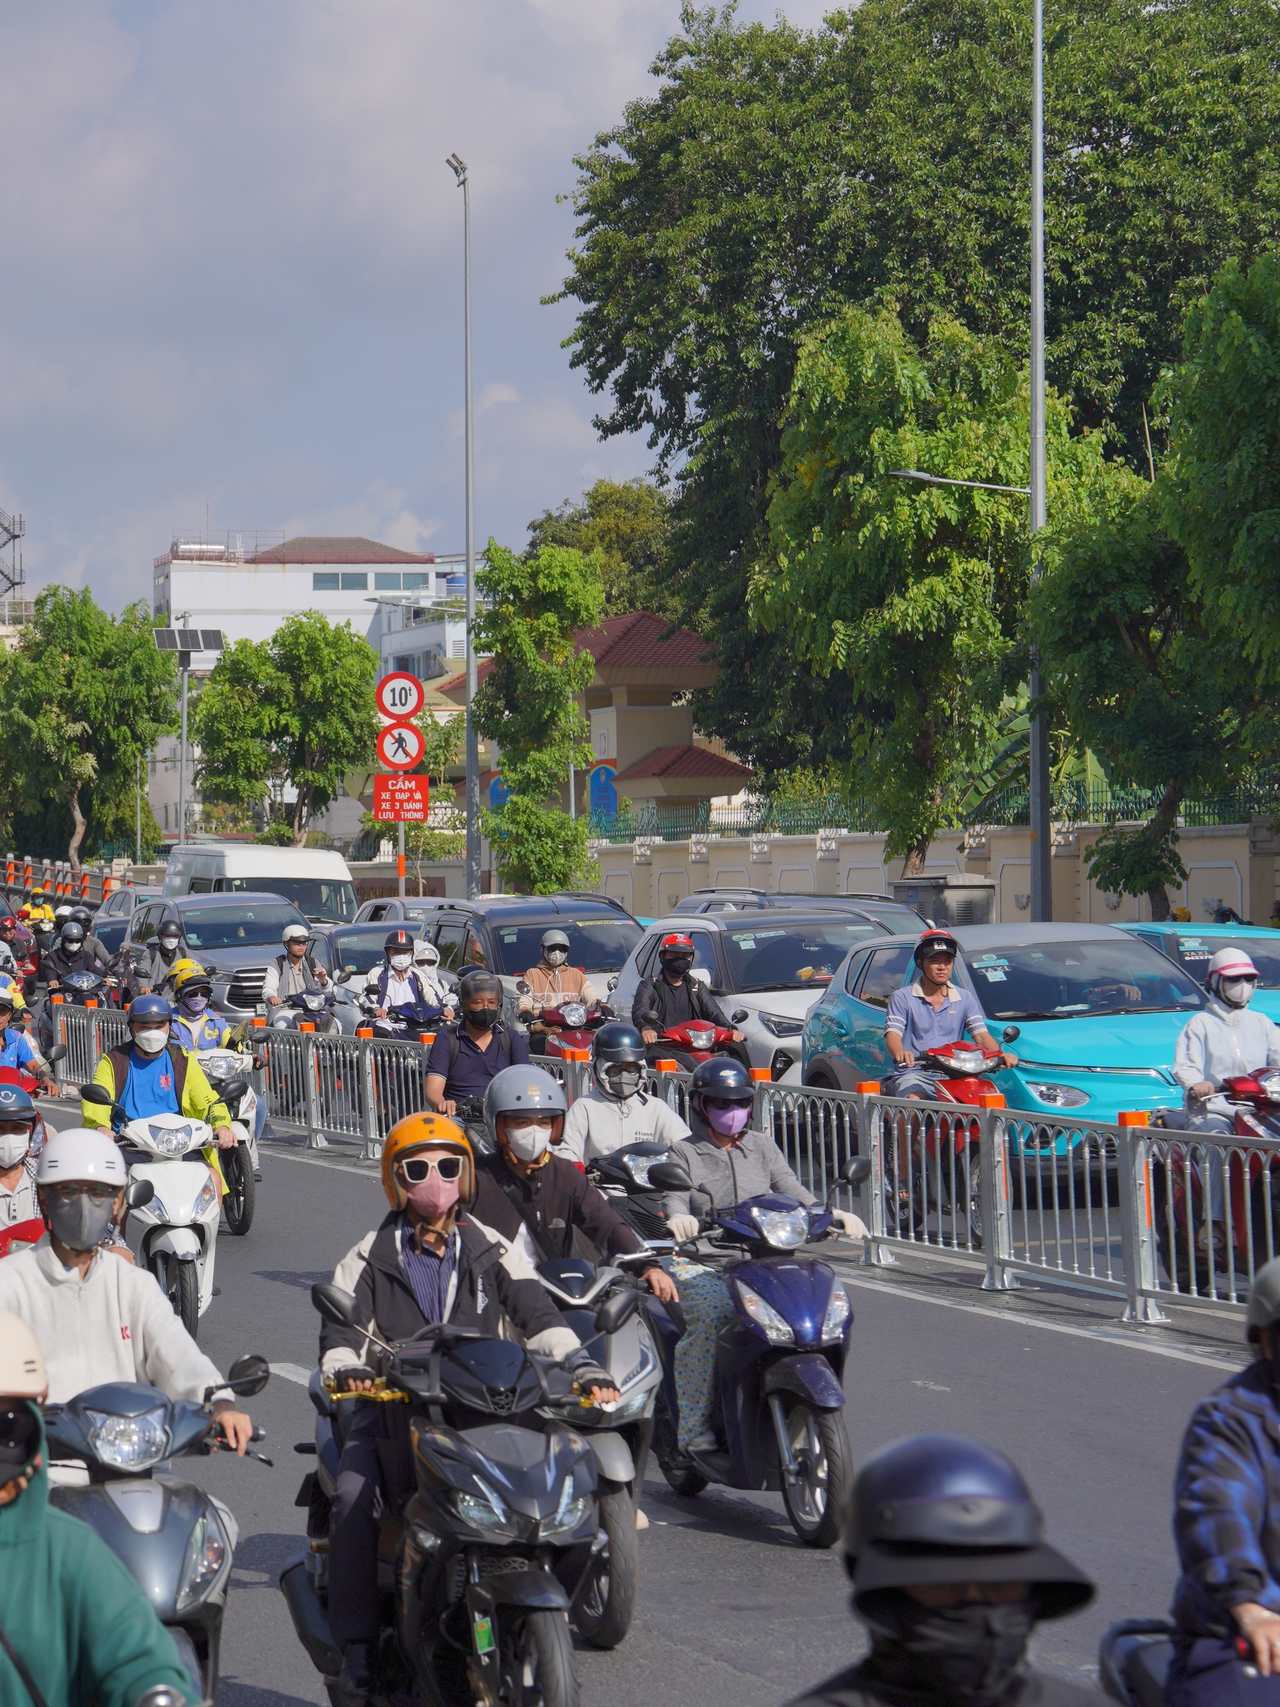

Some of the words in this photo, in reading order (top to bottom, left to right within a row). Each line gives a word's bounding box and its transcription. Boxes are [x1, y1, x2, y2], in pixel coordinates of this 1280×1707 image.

[388, 776, 416, 790] CẤM
[381, 792, 391, 800] XE
[395, 792, 410, 801] ĐẠP
[413, 791, 423, 800] VÀ
[381, 802, 391, 810] XE
[394, 802, 400, 810] 3
[403, 801, 423, 810] BÁNH
[378, 811, 395, 820] LƯU
[400, 811, 424, 820] THÔNG
